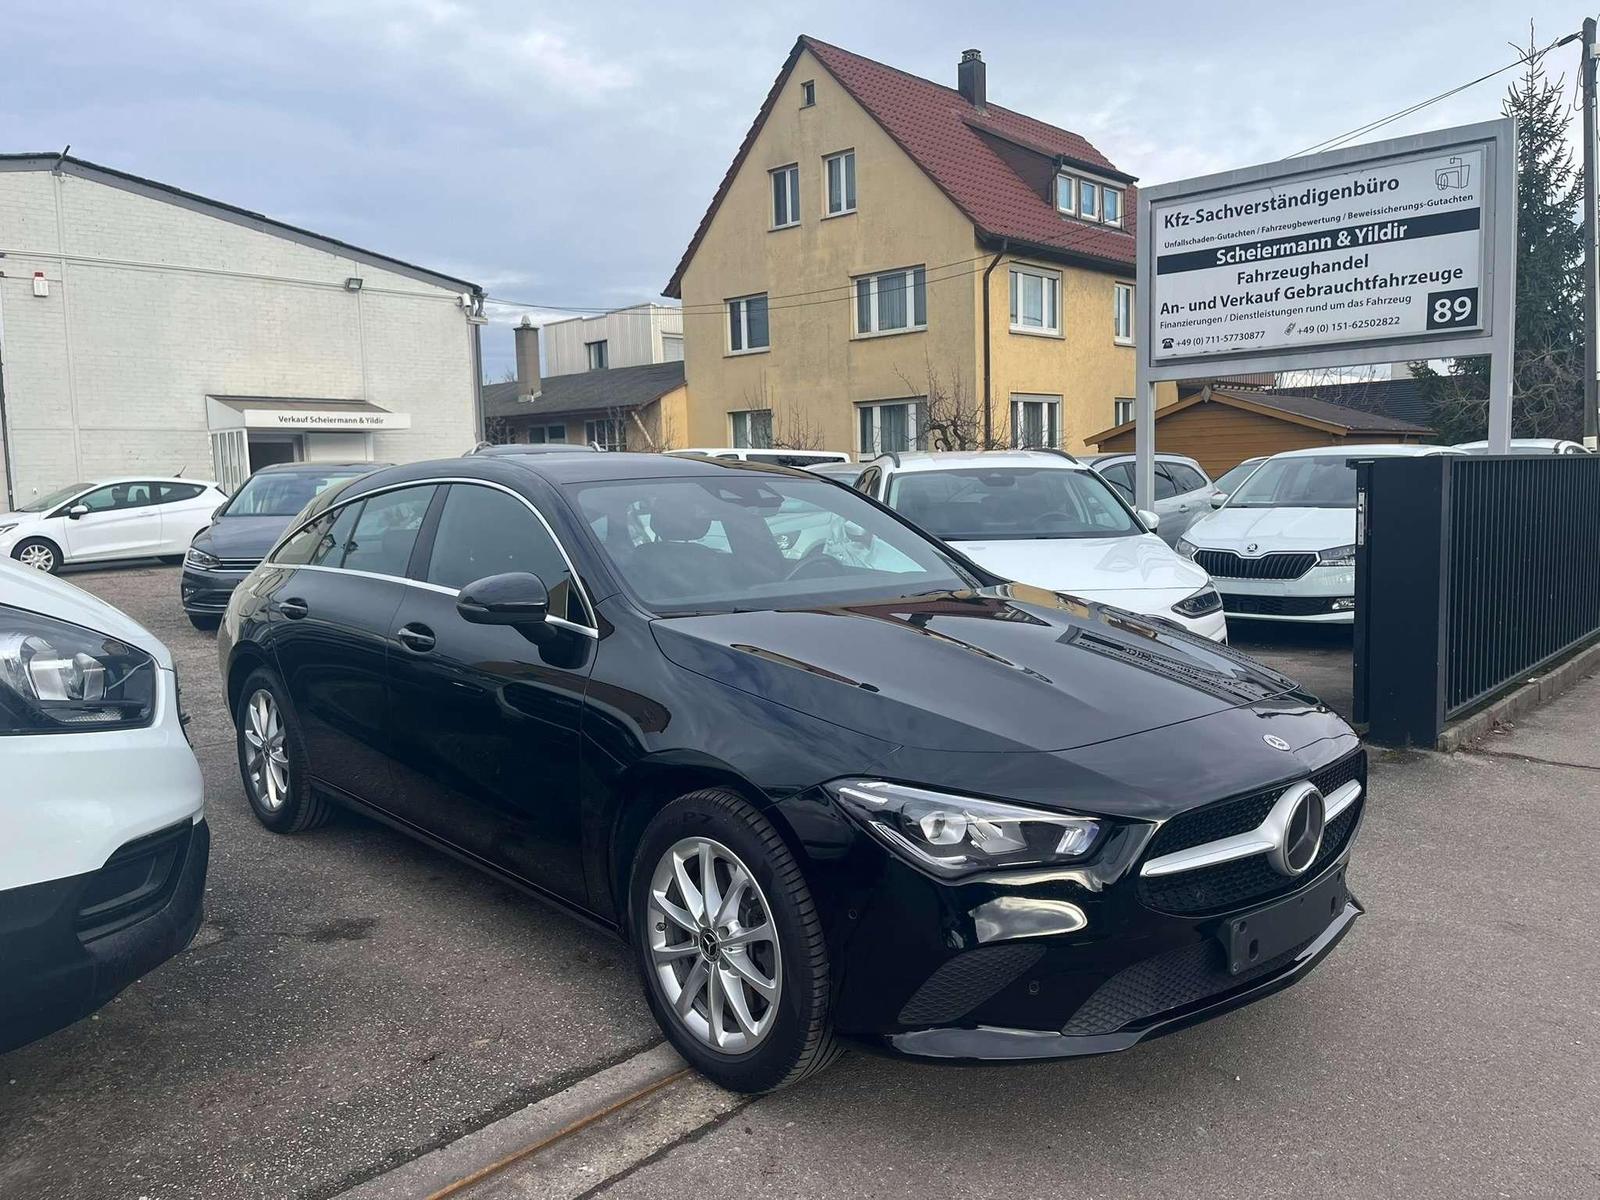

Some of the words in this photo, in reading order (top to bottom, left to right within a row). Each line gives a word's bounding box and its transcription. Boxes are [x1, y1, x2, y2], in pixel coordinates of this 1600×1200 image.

[1164, 178, 1400, 229] Kfz-Sachverständigenbüro
[1164, 228, 1256, 249] Unfallschaden-Gutachten
[1261, 213, 1341, 234] Fahrzeugbewertung
[1347, 194, 1474, 220] Beweissicherungs-Gutachten
[1216, 237, 1332, 265] Scheiermann
[1336, 230, 1351, 247] &
[1355, 222, 1408, 244] Yildir
[1237, 254, 1369, 285] Fahrzeughandel
[1160, 302, 1185, 315] An-
[1188, 296, 1217, 312] und
[1220, 287, 1281, 308] Verkauf
[1284, 267, 1464, 300] Gebrauchtfahrzeuge
[1160, 316, 1223, 329] Finanzierungen
[1229, 307, 1304, 322] Dienstleistungen
[1305, 301, 1328, 313] rund
[1329, 302, 1345, 310] um
[1347, 299, 1364, 308] das
[1366, 295, 1412, 306] Fahrzeug
[1297, 324, 1315, 335] +49
[1316, 323, 1329, 334] (0)
[1331, 316, 1400, 331] 151-62502822
[1433, 296, 1472, 323] 89
[1176, 339, 1192, 347] +49
[1193, 337, 1204, 347] (0)
[1205, 331, 1266, 344] 711-57730877
[278, 416, 308, 424] Verkauf
[309, 416, 358, 424] Scheiermann
